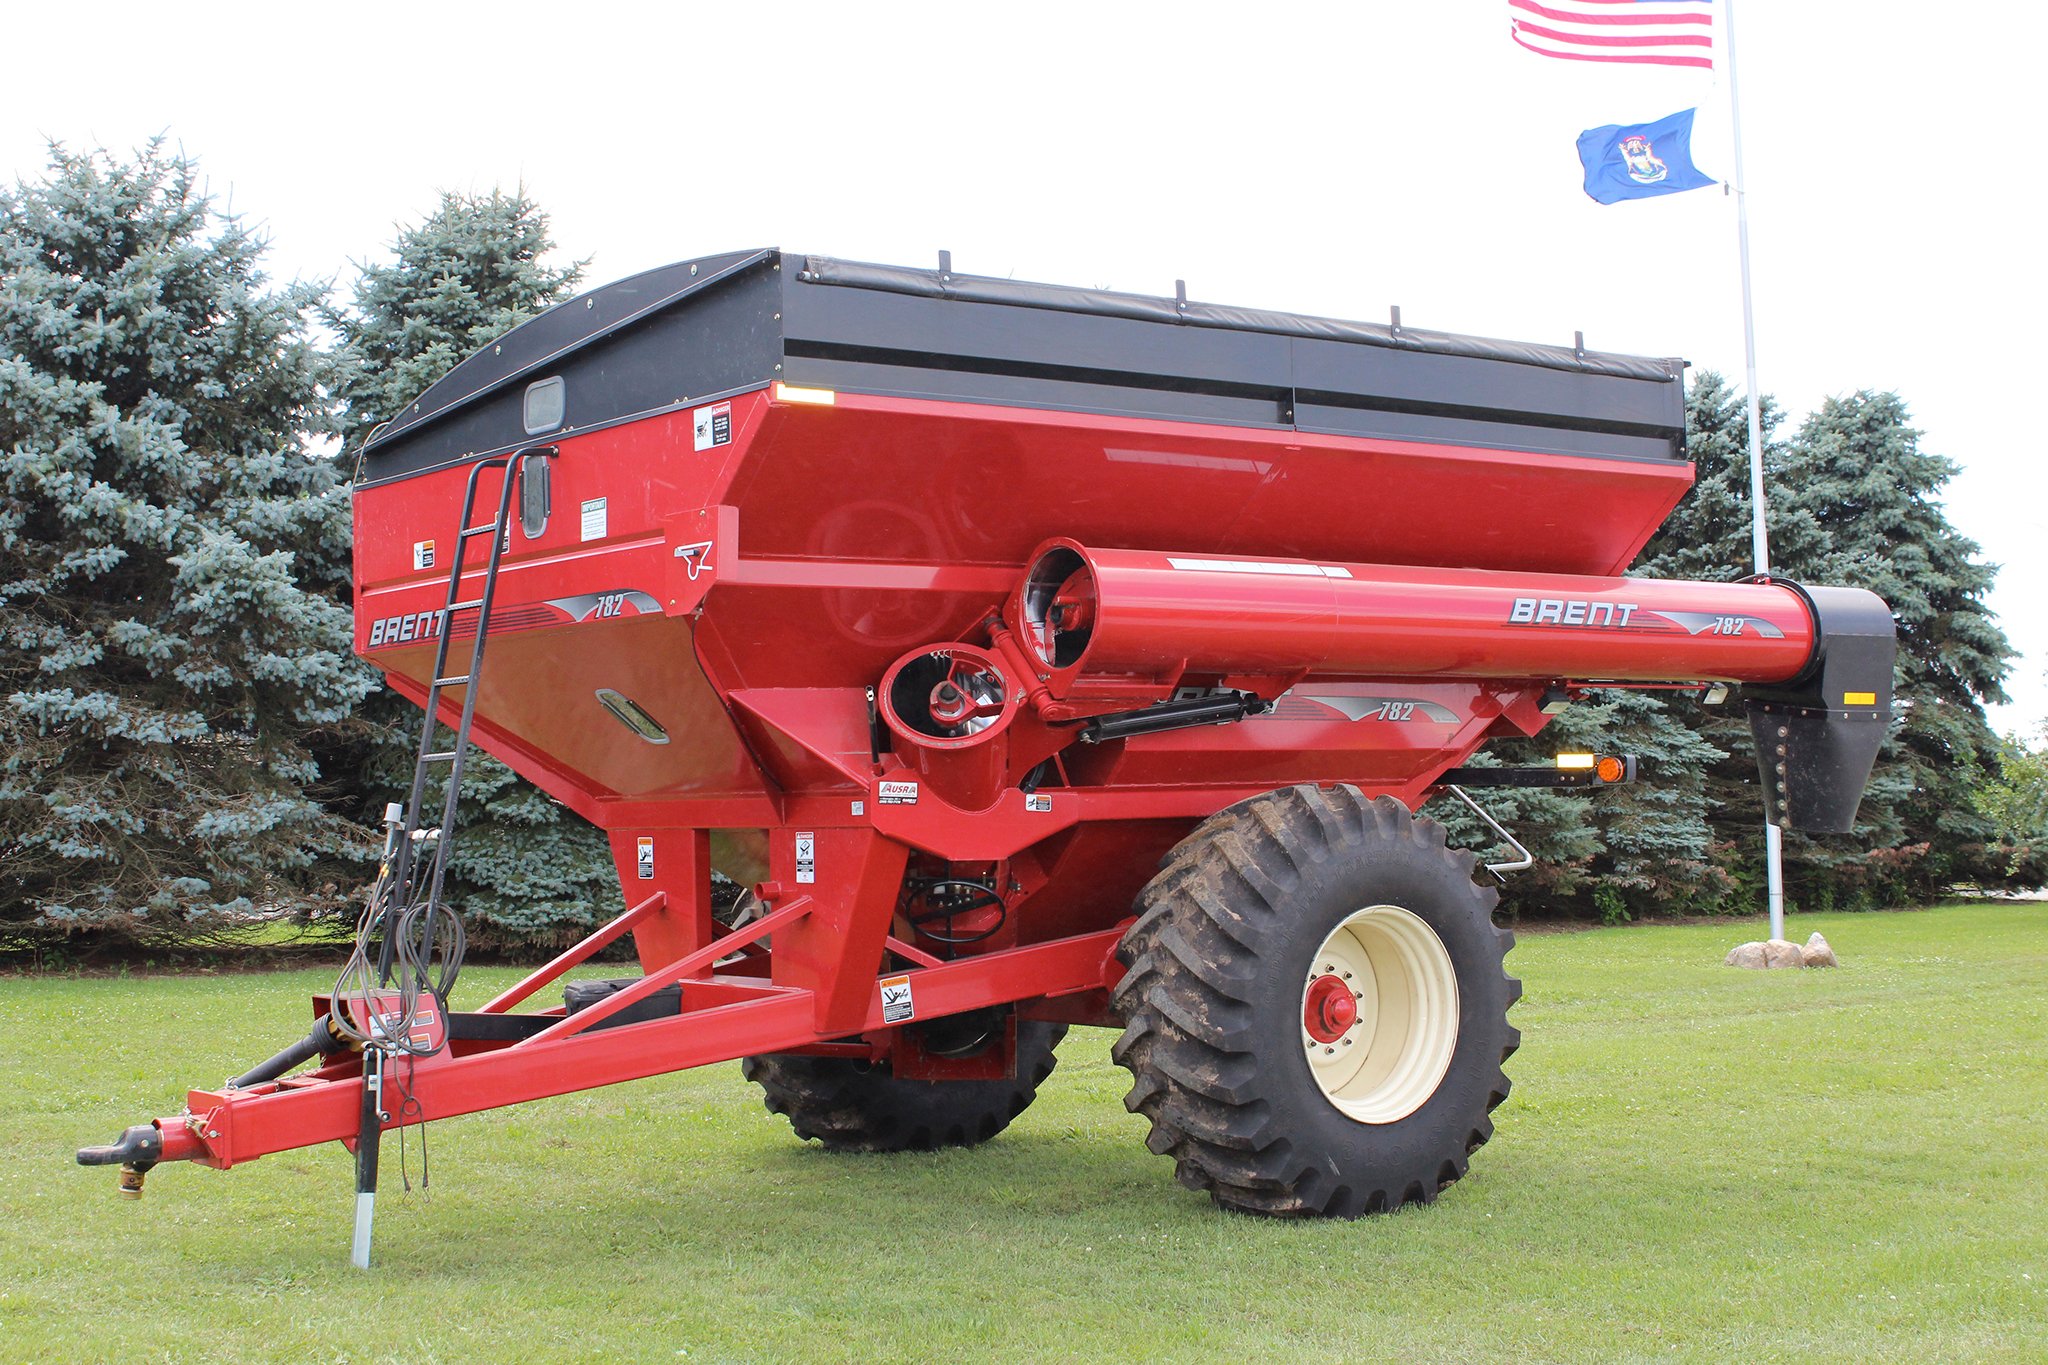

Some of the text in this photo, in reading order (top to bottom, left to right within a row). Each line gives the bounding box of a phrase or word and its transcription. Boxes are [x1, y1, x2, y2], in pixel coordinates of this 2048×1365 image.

[594, 593, 625, 619] 782
[1508, 597, 1638, 628] BRENT
[368, 608, 447, 647] BRENT
[1713, 616, 1745, 636] 782
[1377, 702, 1415, 721] 782
